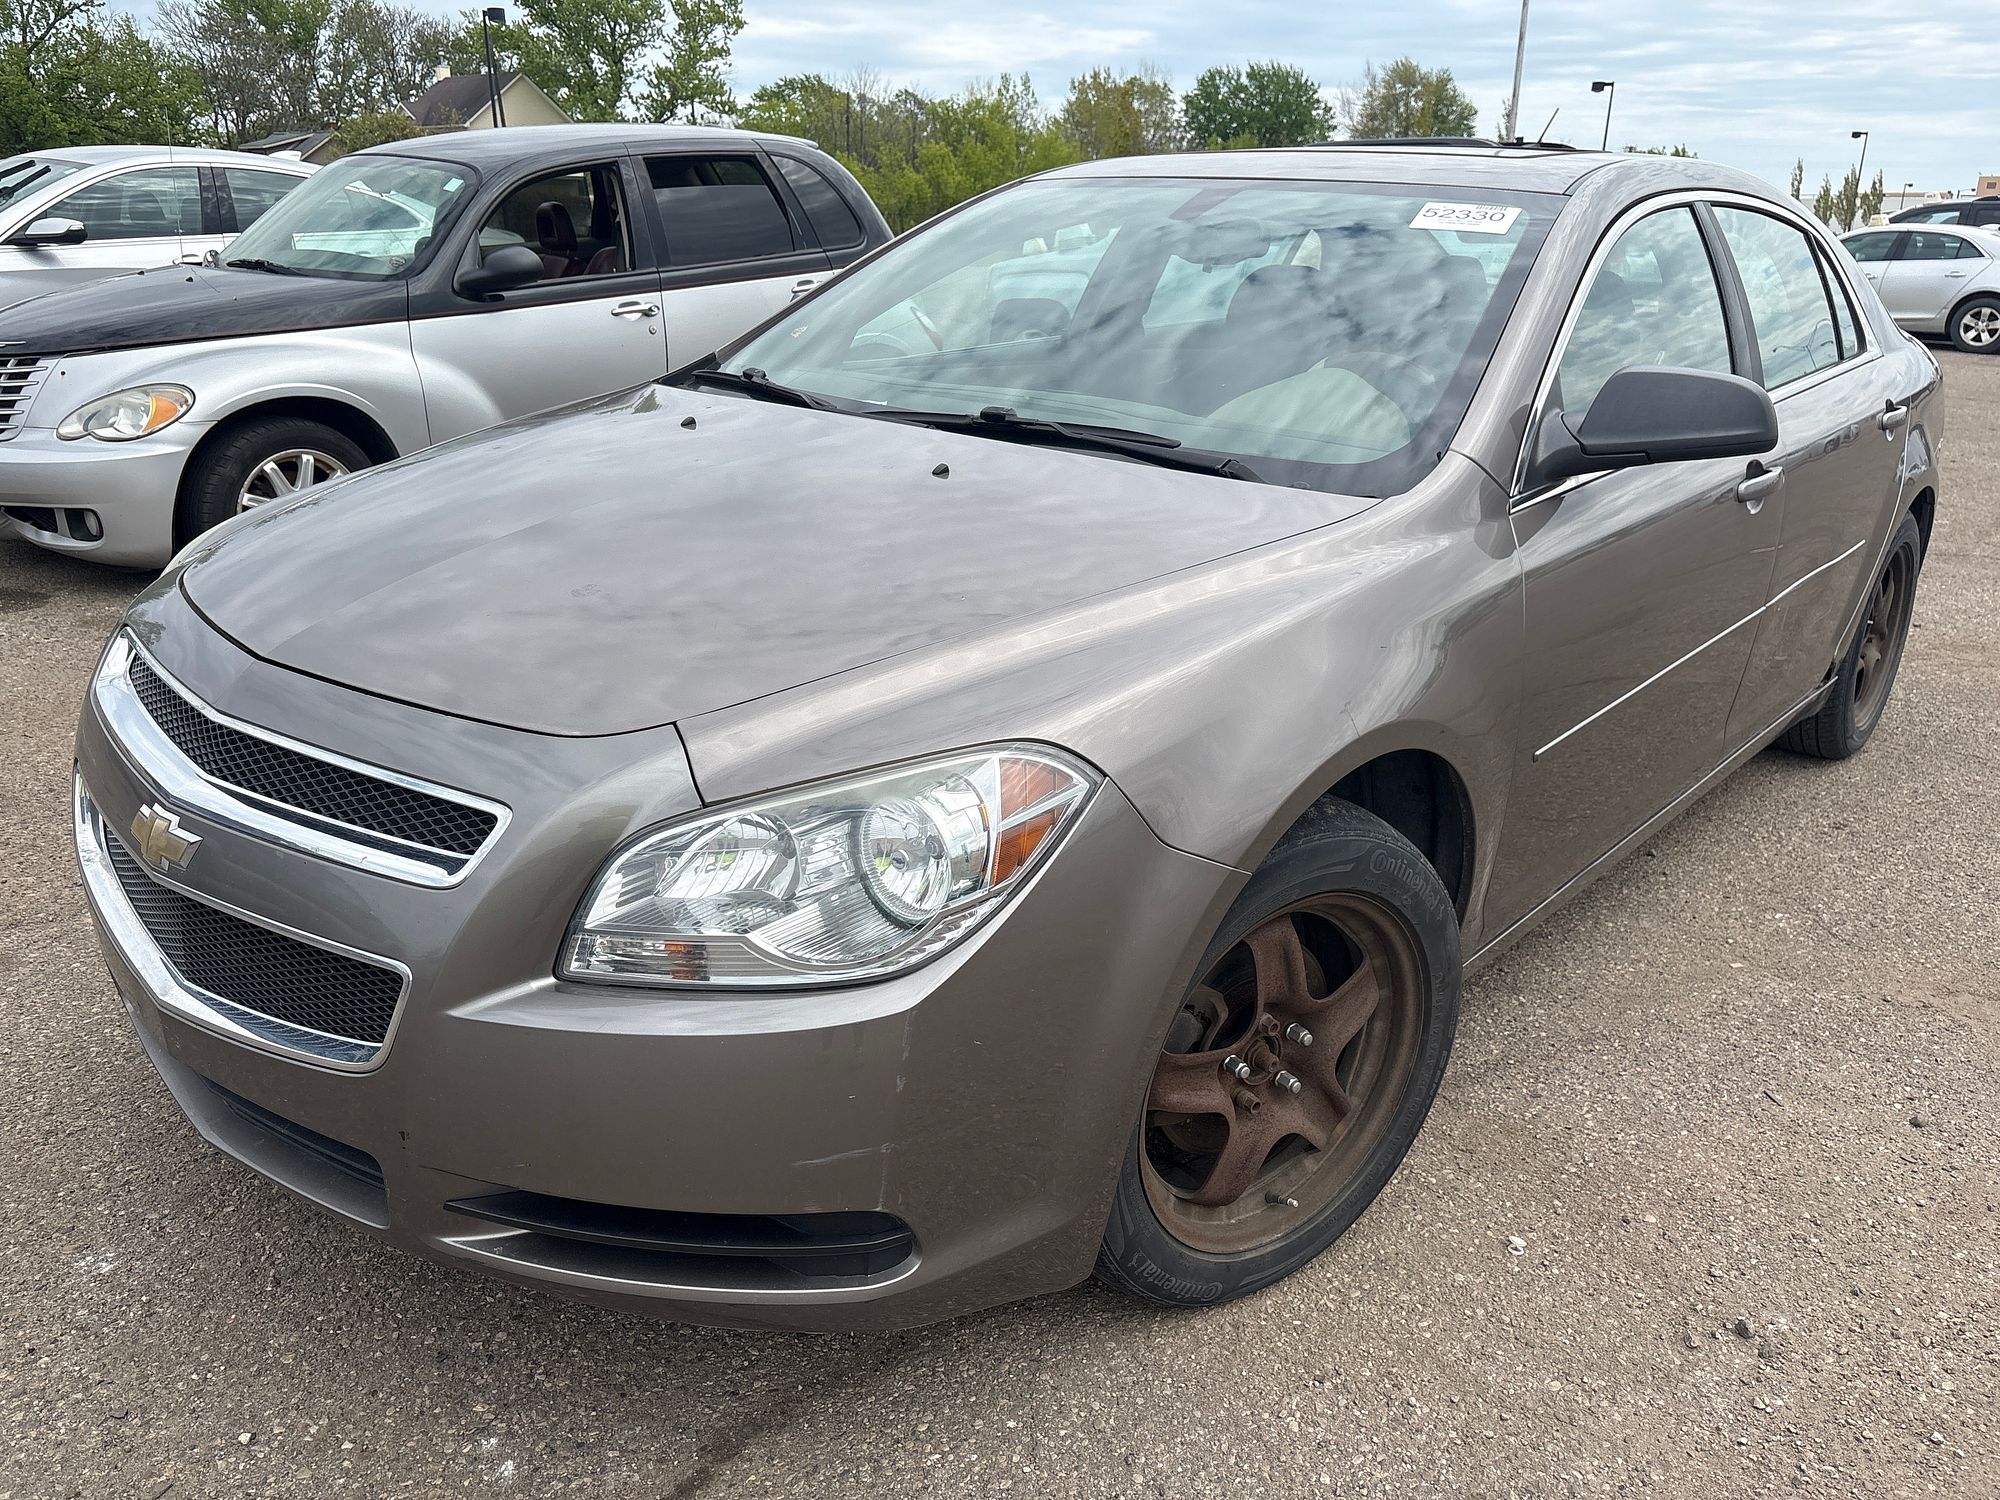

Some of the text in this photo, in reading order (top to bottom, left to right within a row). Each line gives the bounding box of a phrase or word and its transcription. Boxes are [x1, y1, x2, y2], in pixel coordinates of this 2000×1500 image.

[1422, 208, 1506, 222] 52330
[1369, 849, 1441, 912] Continental
[1134, 1259, 1223, 1302] Continental
